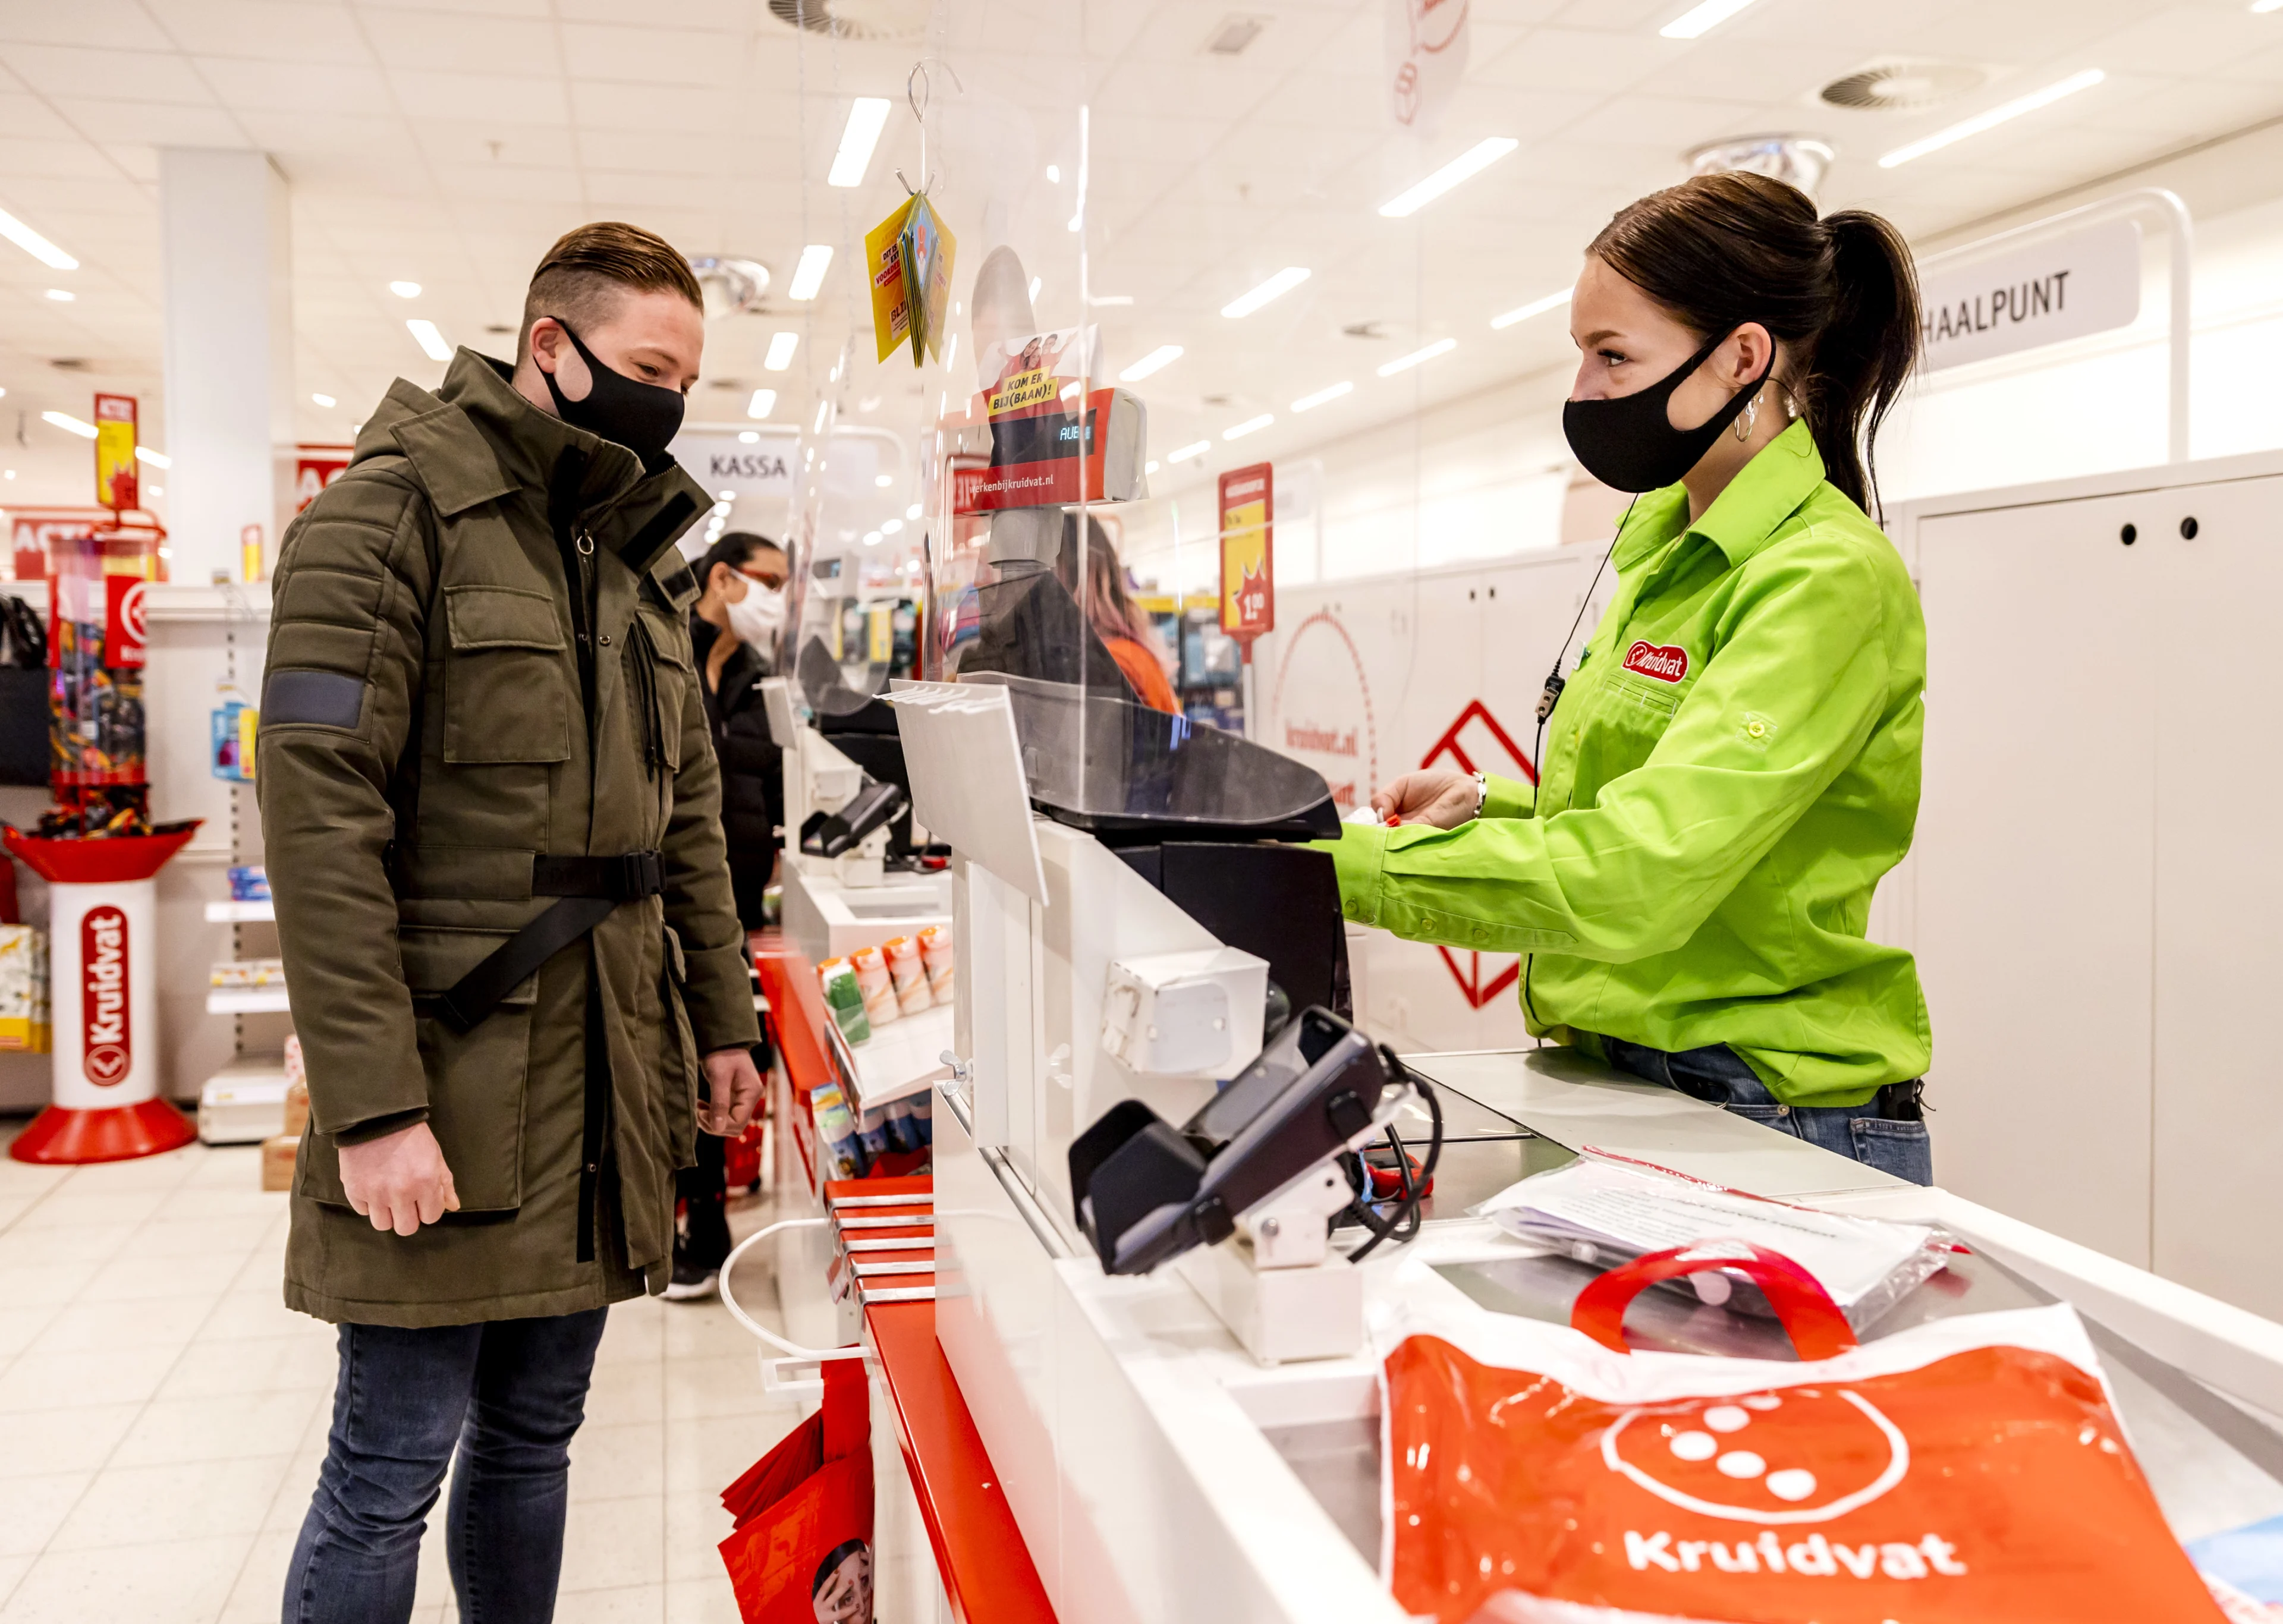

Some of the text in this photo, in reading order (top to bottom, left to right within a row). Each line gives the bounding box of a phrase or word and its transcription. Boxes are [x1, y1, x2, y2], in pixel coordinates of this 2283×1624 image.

[883, 243, 897, 260] DIT IS
[1007, 372, 1043, 392] KOM ER
[993, 383, 1052, 410] BIJ(BAAN)!
[710, 454, 788, 478] KASSA
[969, 474, 1054, 494] werkenbijkruidvat.nl
[1636, 652, 1683, 676] Kruidvat
[87, 914, 124, 1045] Kruidvat
[1624, 1529, 1968, 1580] Kruidvat
